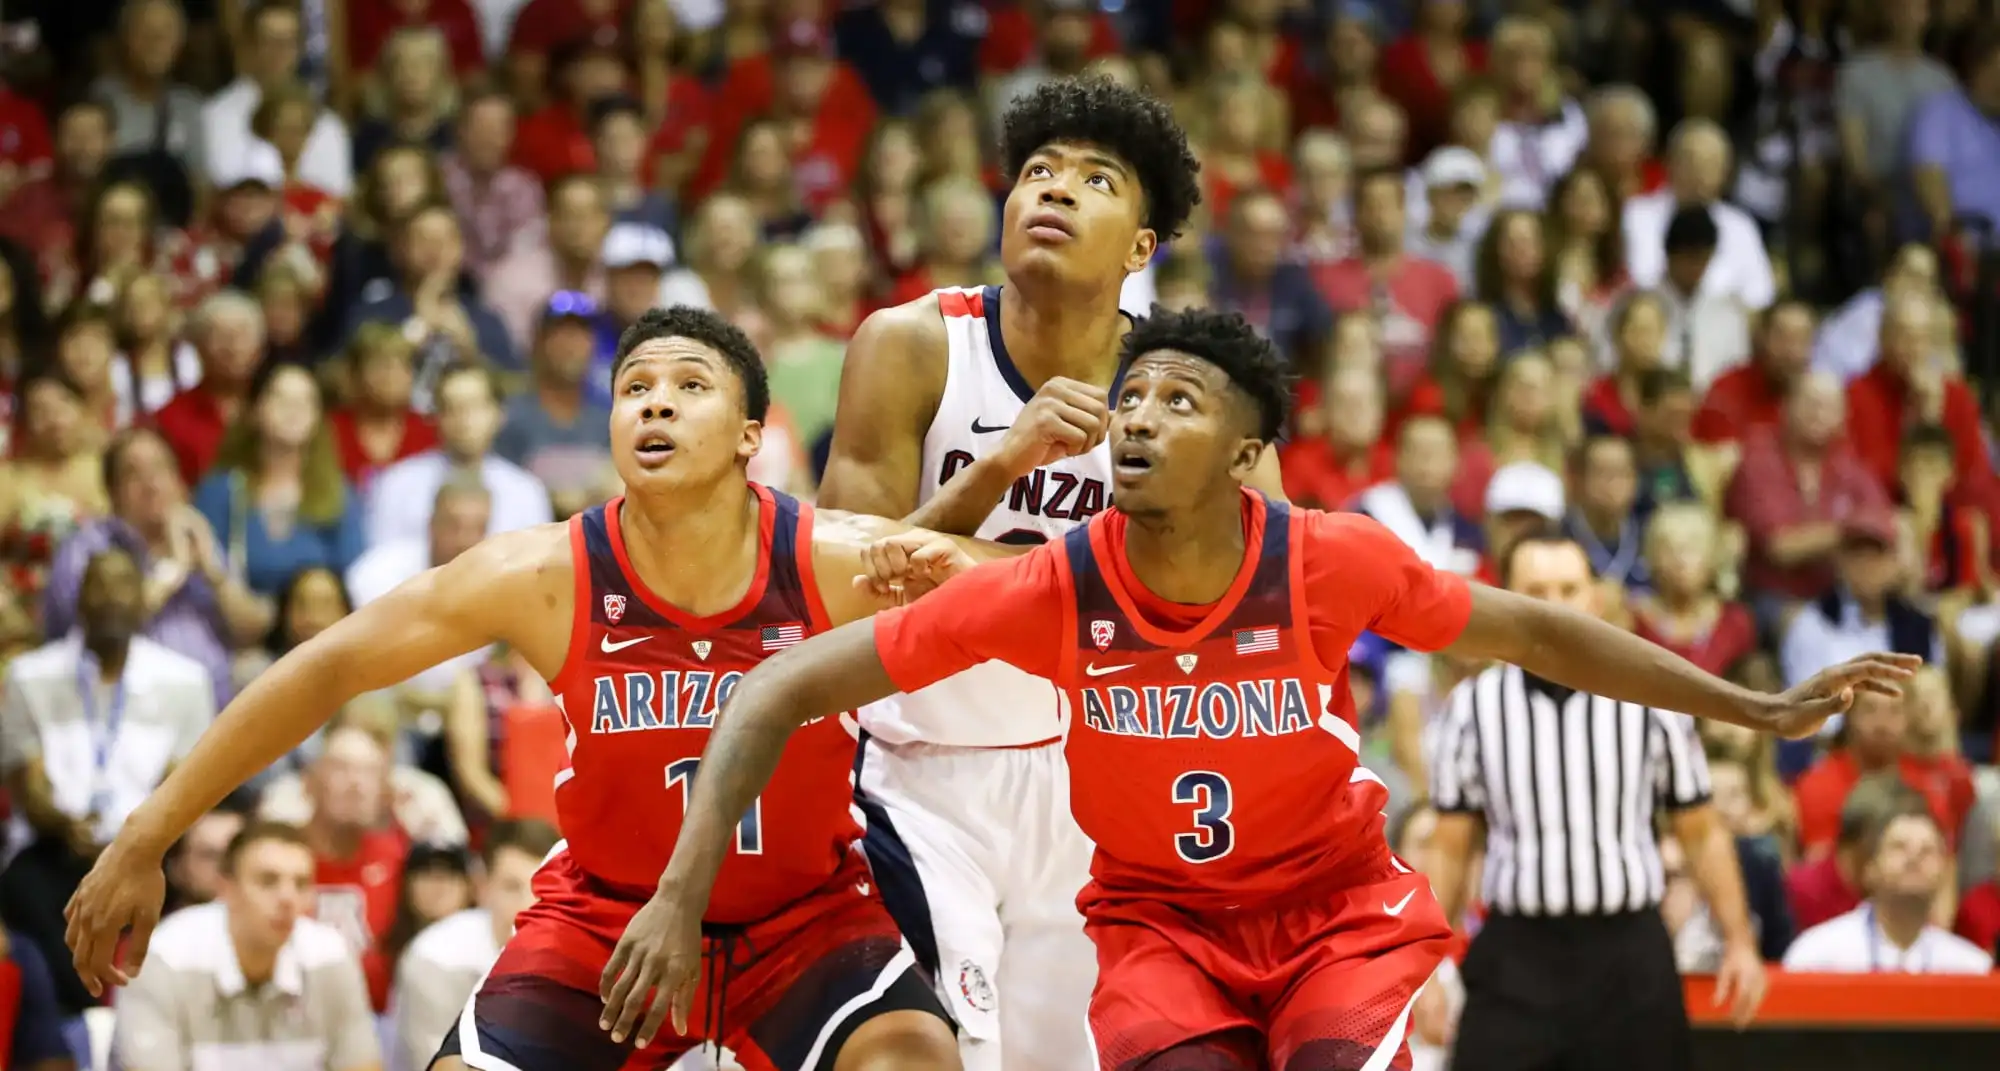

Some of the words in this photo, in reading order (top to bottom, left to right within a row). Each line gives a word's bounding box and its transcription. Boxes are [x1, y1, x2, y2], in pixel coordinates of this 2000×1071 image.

[939, 449, 1115, 522] NZA
[591, 670, 824, 734] ARIZ
[1081, 678, 1313, 740] ARIZONA
[1171, 770, 1235, 864] 3
